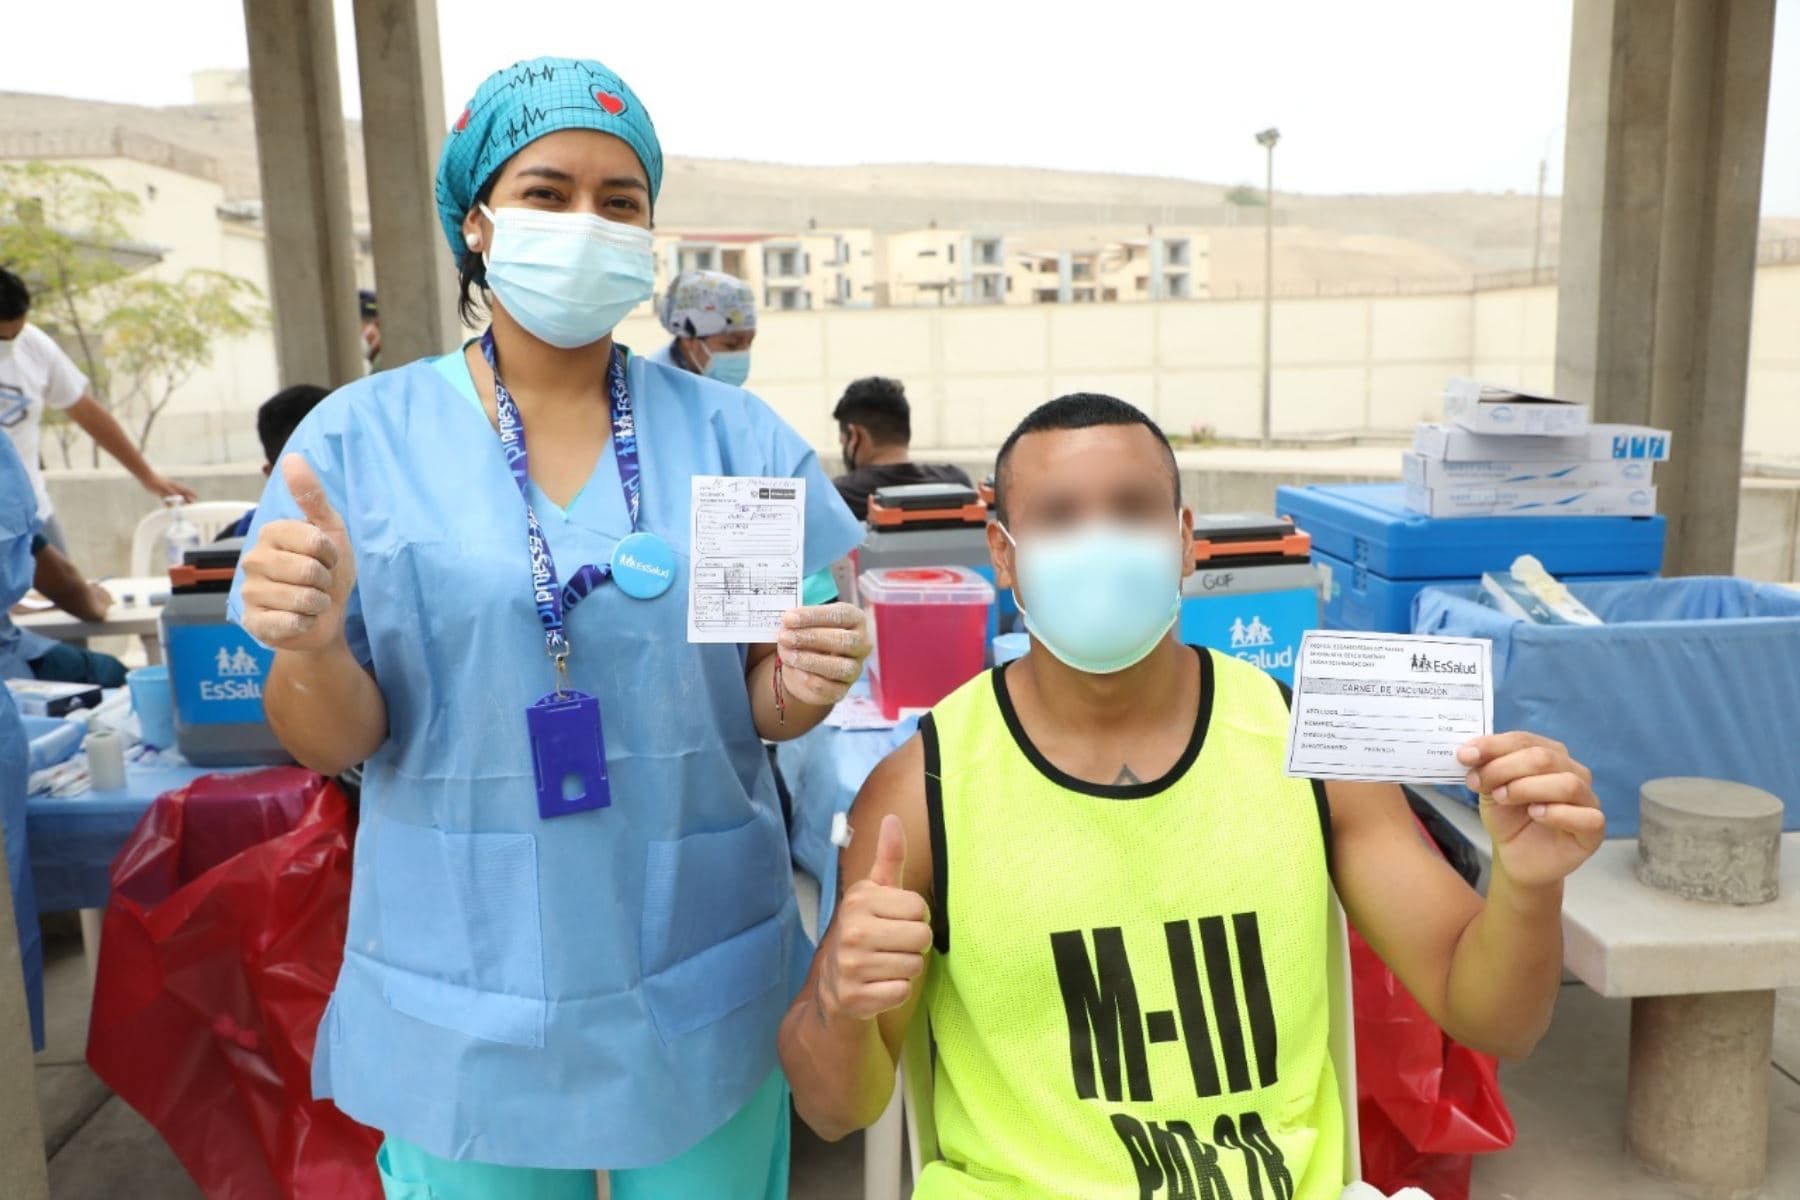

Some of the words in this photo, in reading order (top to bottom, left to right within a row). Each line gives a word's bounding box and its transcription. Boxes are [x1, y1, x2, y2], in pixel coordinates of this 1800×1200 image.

[529, 536, 554, 602] EsSalud
[636, 561, 670, 578] EsSalud
[1433, 660, 1476, 674] EsSalud
[200, 679, 263, 700] EsSalu
[1342, 684, 1376, 693] CARNET
[1380, 685, 1392, 694] DE
[1050, 911, 1279, 1102] M-III
